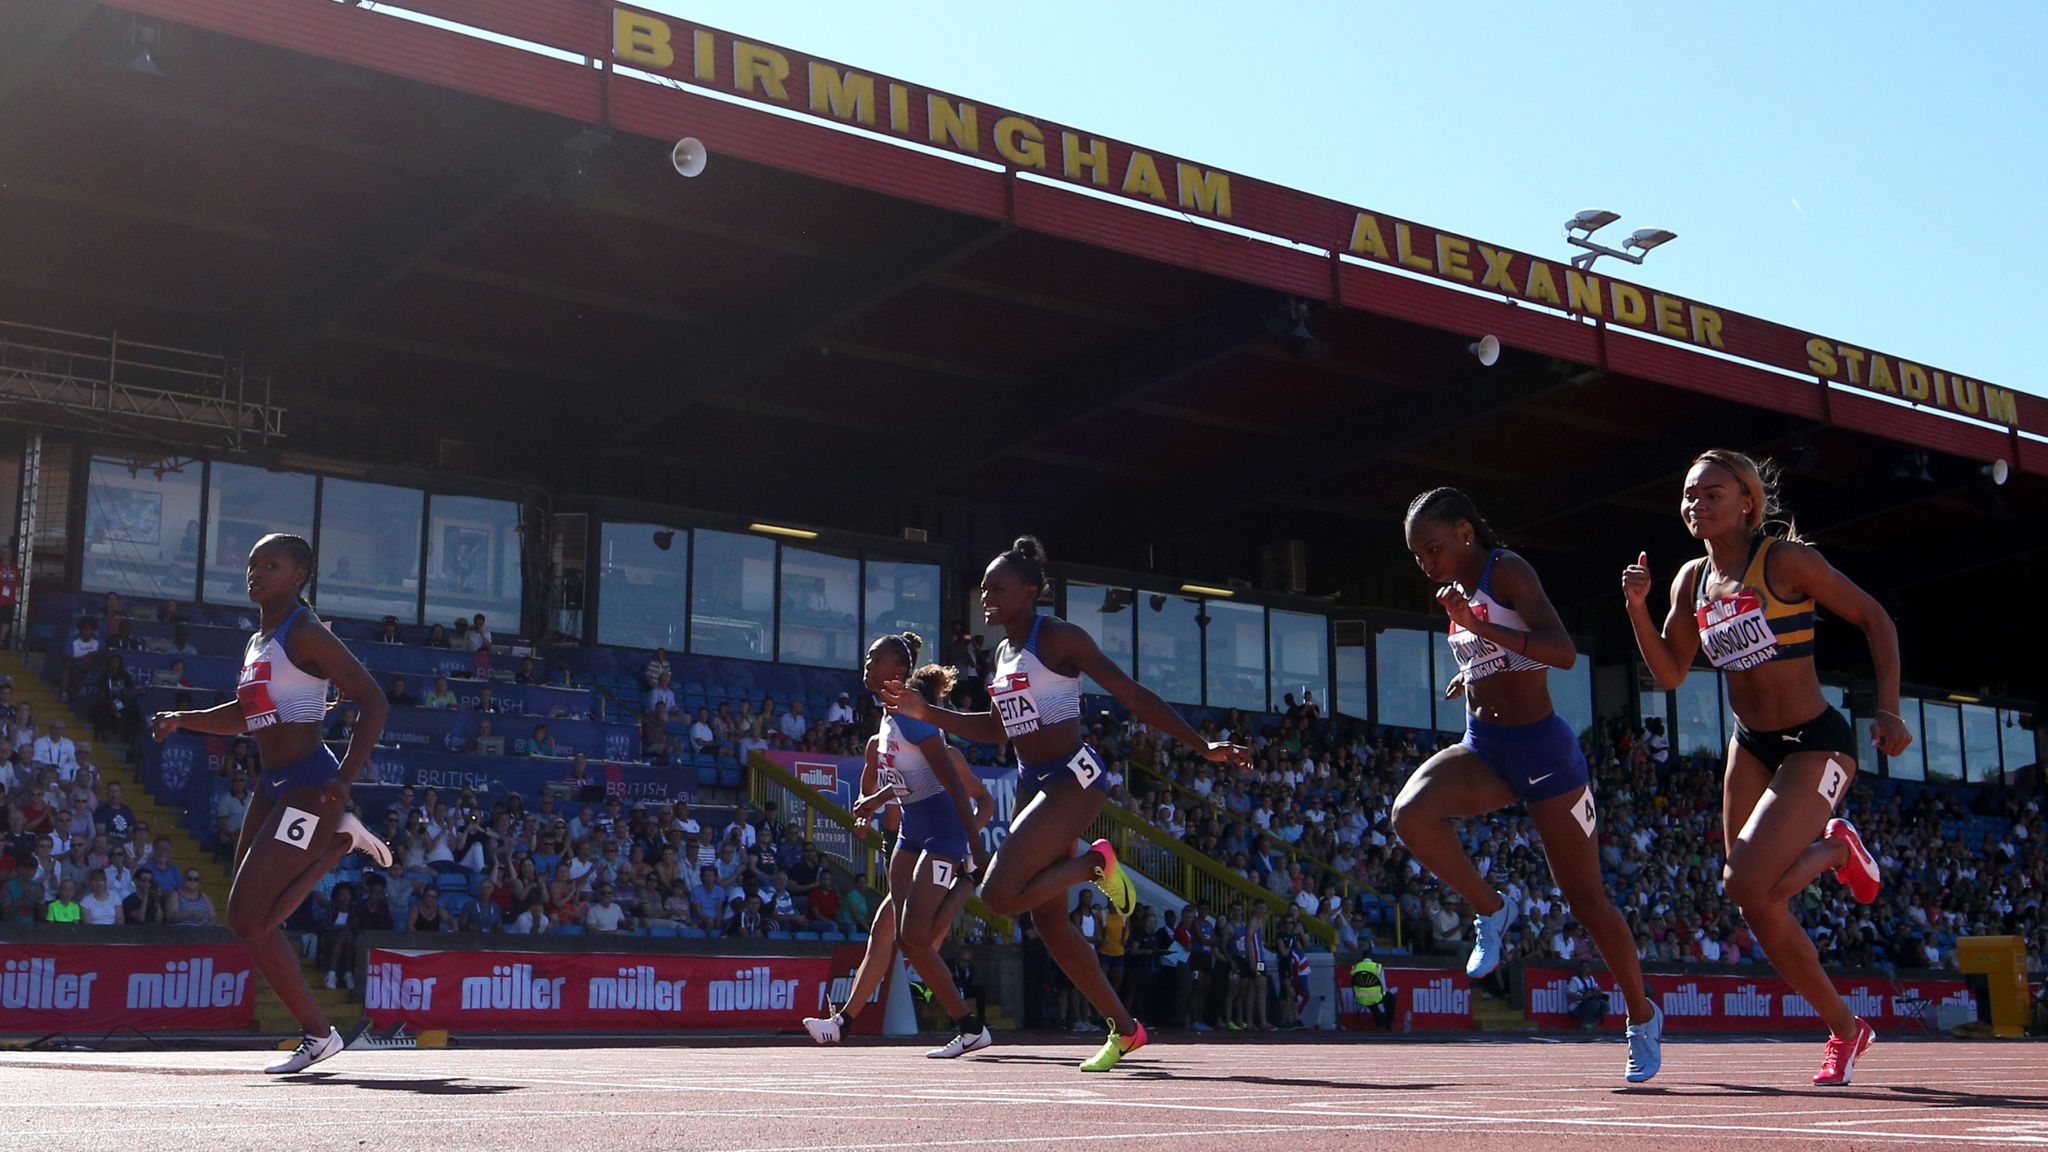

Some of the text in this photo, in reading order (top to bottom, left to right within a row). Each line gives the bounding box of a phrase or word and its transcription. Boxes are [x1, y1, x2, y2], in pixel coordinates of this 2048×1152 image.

[612, 7, 2018, 425] BIRMINGHAM ALEXANDER STADIUM
[1704, 615, 1767, 660] LANSIQUOT
[999, 695, 1035, 720] EITA
[417, 768, 488, 788] BRITISH
[800, 769, 833, 787] müller
[1077, 757, 1095, 780] 5
[1827, 770, 1841, 798] 3
[606, 781, 667, 797] BRITISH
[1585, 799, 1595, 823] 4
[287, 816, 305, 841] 6
[939, 865, 948, 882] 7
[0, 957, 97, 1009] üller
[127, 957, 249, 1009] müller
[365, 963, 437, 1011] üller
[461, 963, 566, 1010] müller
[588, 965, 686, 1012] müller
[708, 966, 799, 1012] müller
[1412, 978, 1471, 1014] müller
[1531, 979, 1568, 1014] müll
[1663, 983, 1713, 1016] müller
[1724, 984, 1772, 1016] müller
